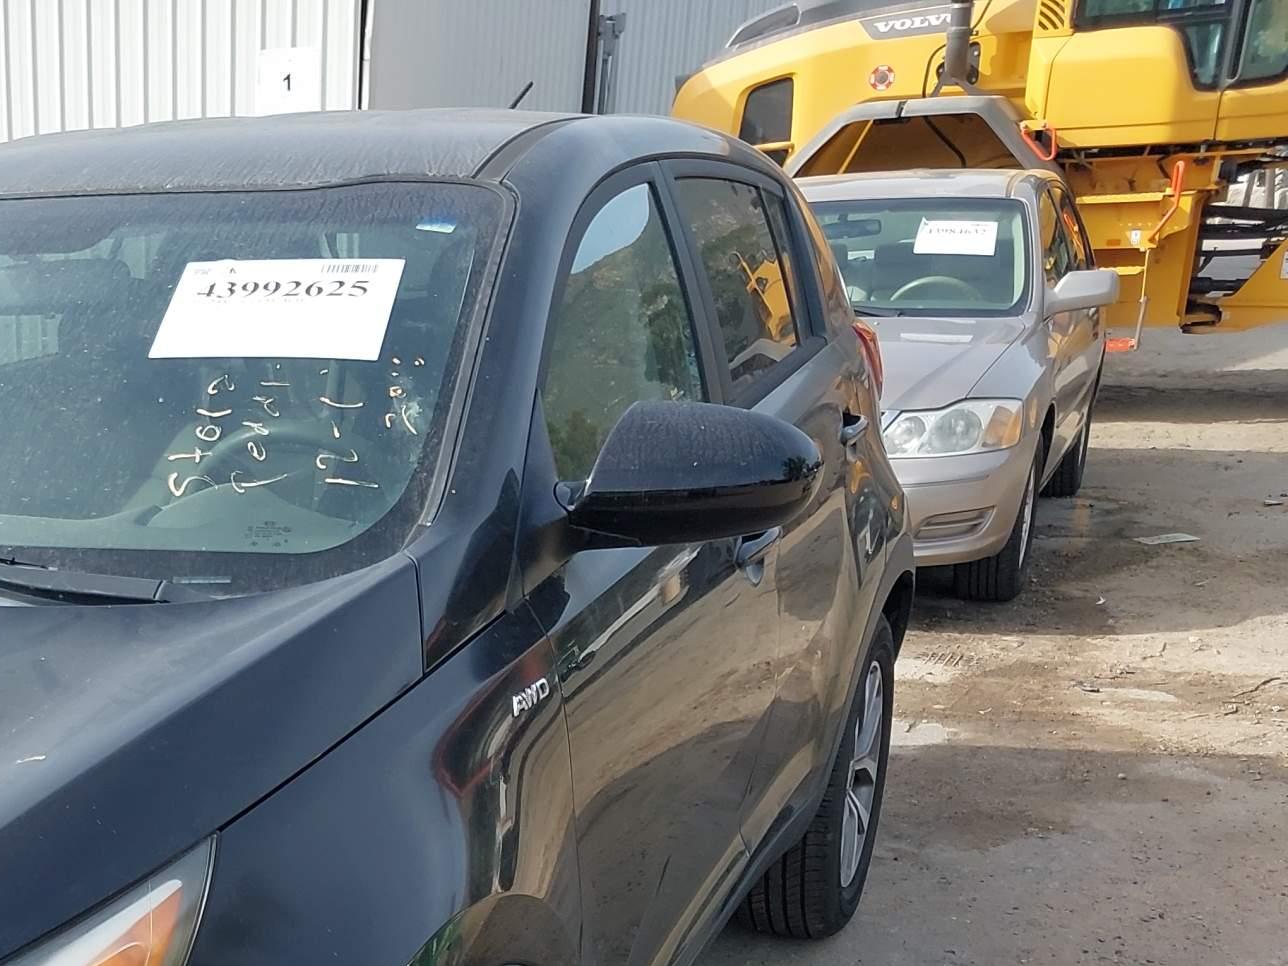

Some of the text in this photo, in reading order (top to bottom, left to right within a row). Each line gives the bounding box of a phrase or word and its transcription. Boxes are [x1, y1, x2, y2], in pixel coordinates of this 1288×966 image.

[282, 73, 291, 91] 1
[196, 280, 370, 298] 43992625
[512, 677, 550, 717] AWD
